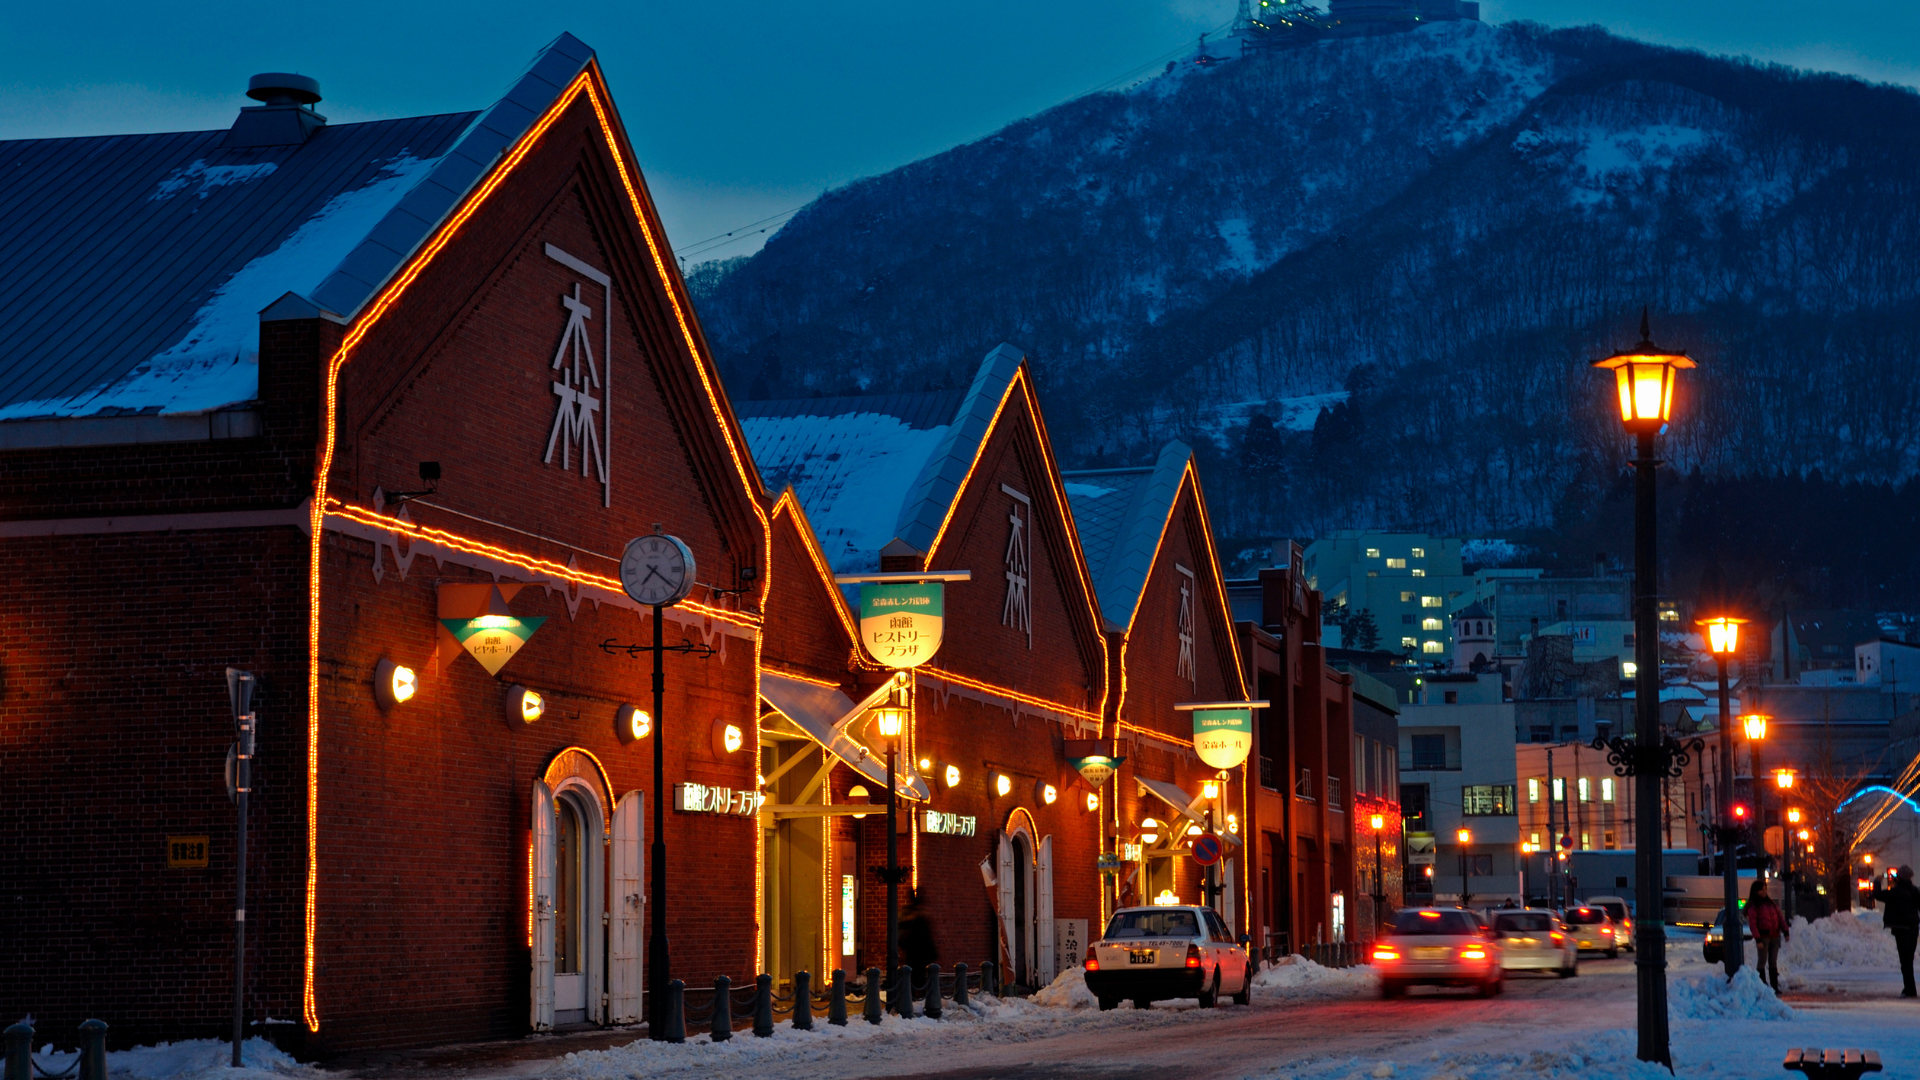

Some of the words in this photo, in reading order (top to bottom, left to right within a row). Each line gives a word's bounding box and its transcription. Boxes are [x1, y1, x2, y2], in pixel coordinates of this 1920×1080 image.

[872, 596, 931, 607] 金森赤レンガ倉庫
[889, 616, 913, 629] 函館
[484, 636, 501, 645] 函館
[873, 630, 930, 643] ヒストリー
[473, 645, 512, 654] ビヤホール
[884, 644, 920, 657] プラザ
[1202, 740, 1243, 750] 金森ホール
[1065, 922, 1078, 969] 函館浪漫
